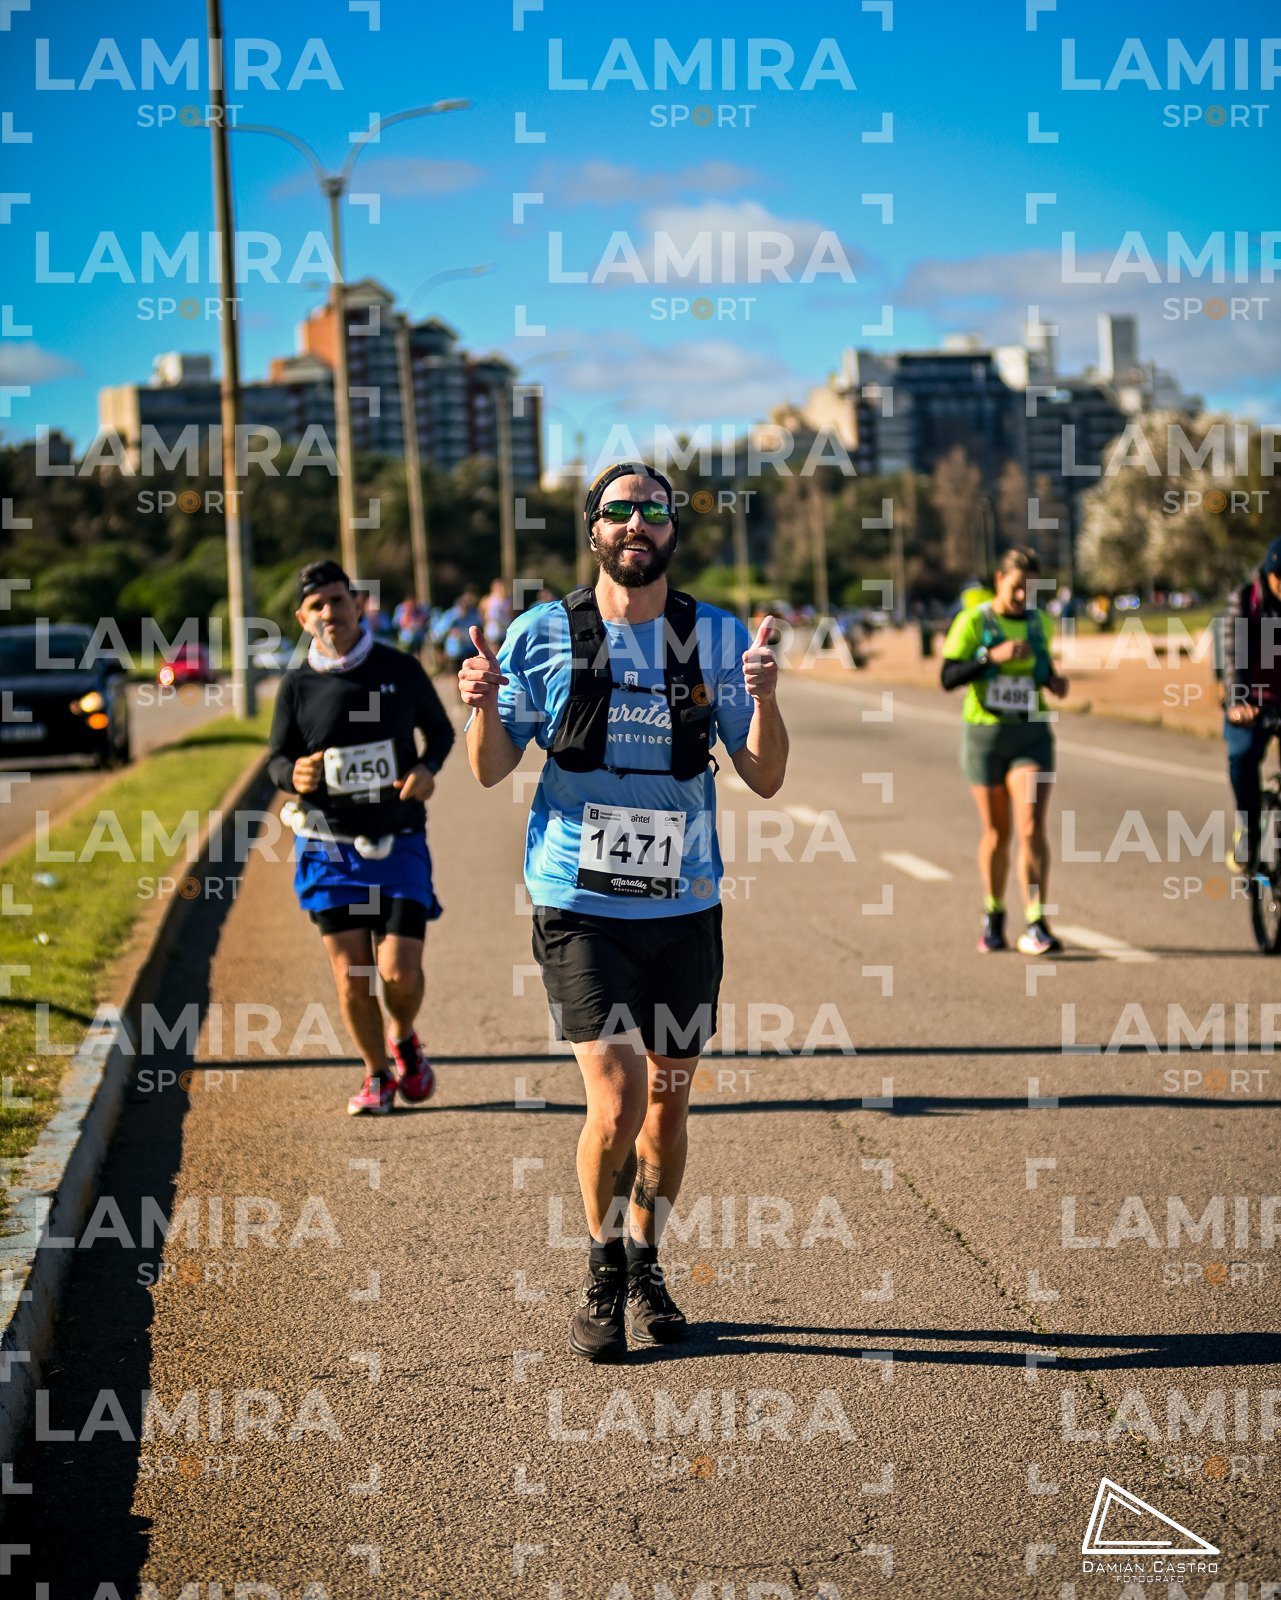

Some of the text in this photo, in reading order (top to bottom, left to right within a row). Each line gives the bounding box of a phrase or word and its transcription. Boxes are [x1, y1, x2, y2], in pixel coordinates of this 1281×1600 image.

[608, 703, 673, 730] arató
[608, 733, 673, 745] NTEVIDEO
[336, 757, 390, 786] 1450
[630, 813, 651, 824] antel
[590, 829, 672, 867] 1471
